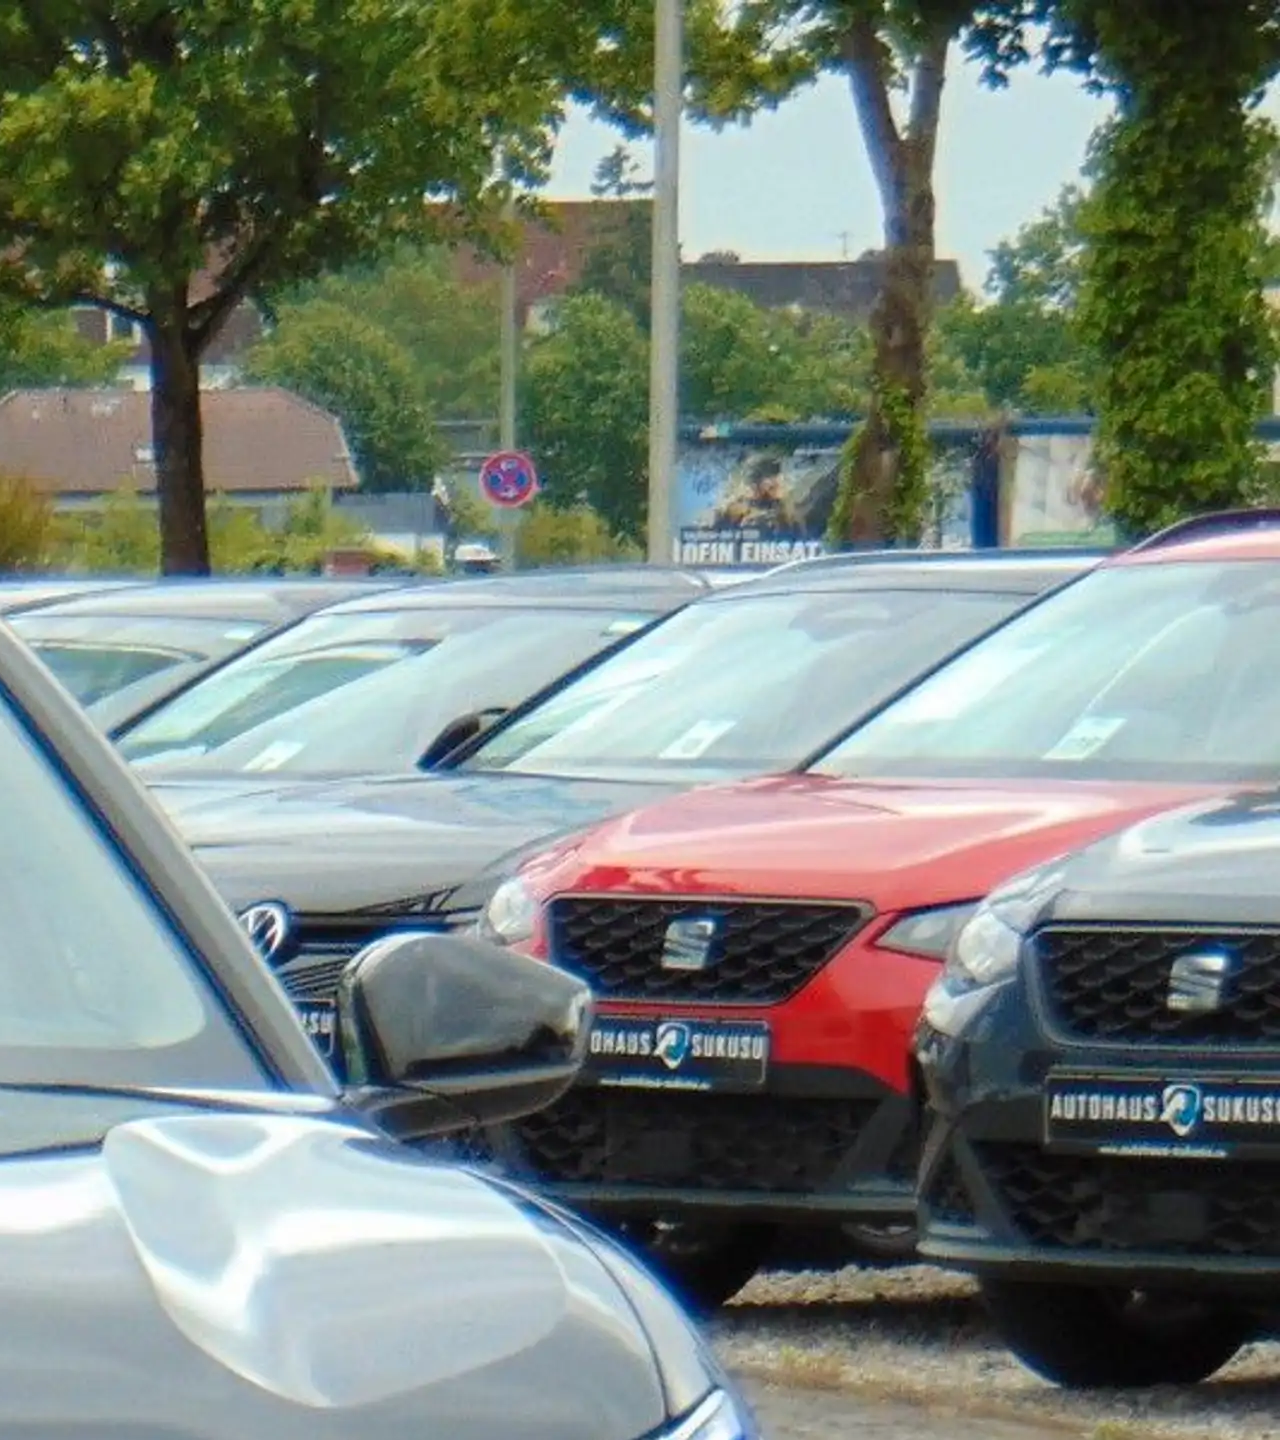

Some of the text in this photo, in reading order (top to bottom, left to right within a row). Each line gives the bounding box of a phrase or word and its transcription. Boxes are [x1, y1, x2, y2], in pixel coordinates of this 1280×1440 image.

[741, 540, 827, 564] EINSAT
[590, 1029, 764, 1060] OHAUS SUKUSU
[1050, 1092, 1280, 1123] AUTOHAUS SUKUS
